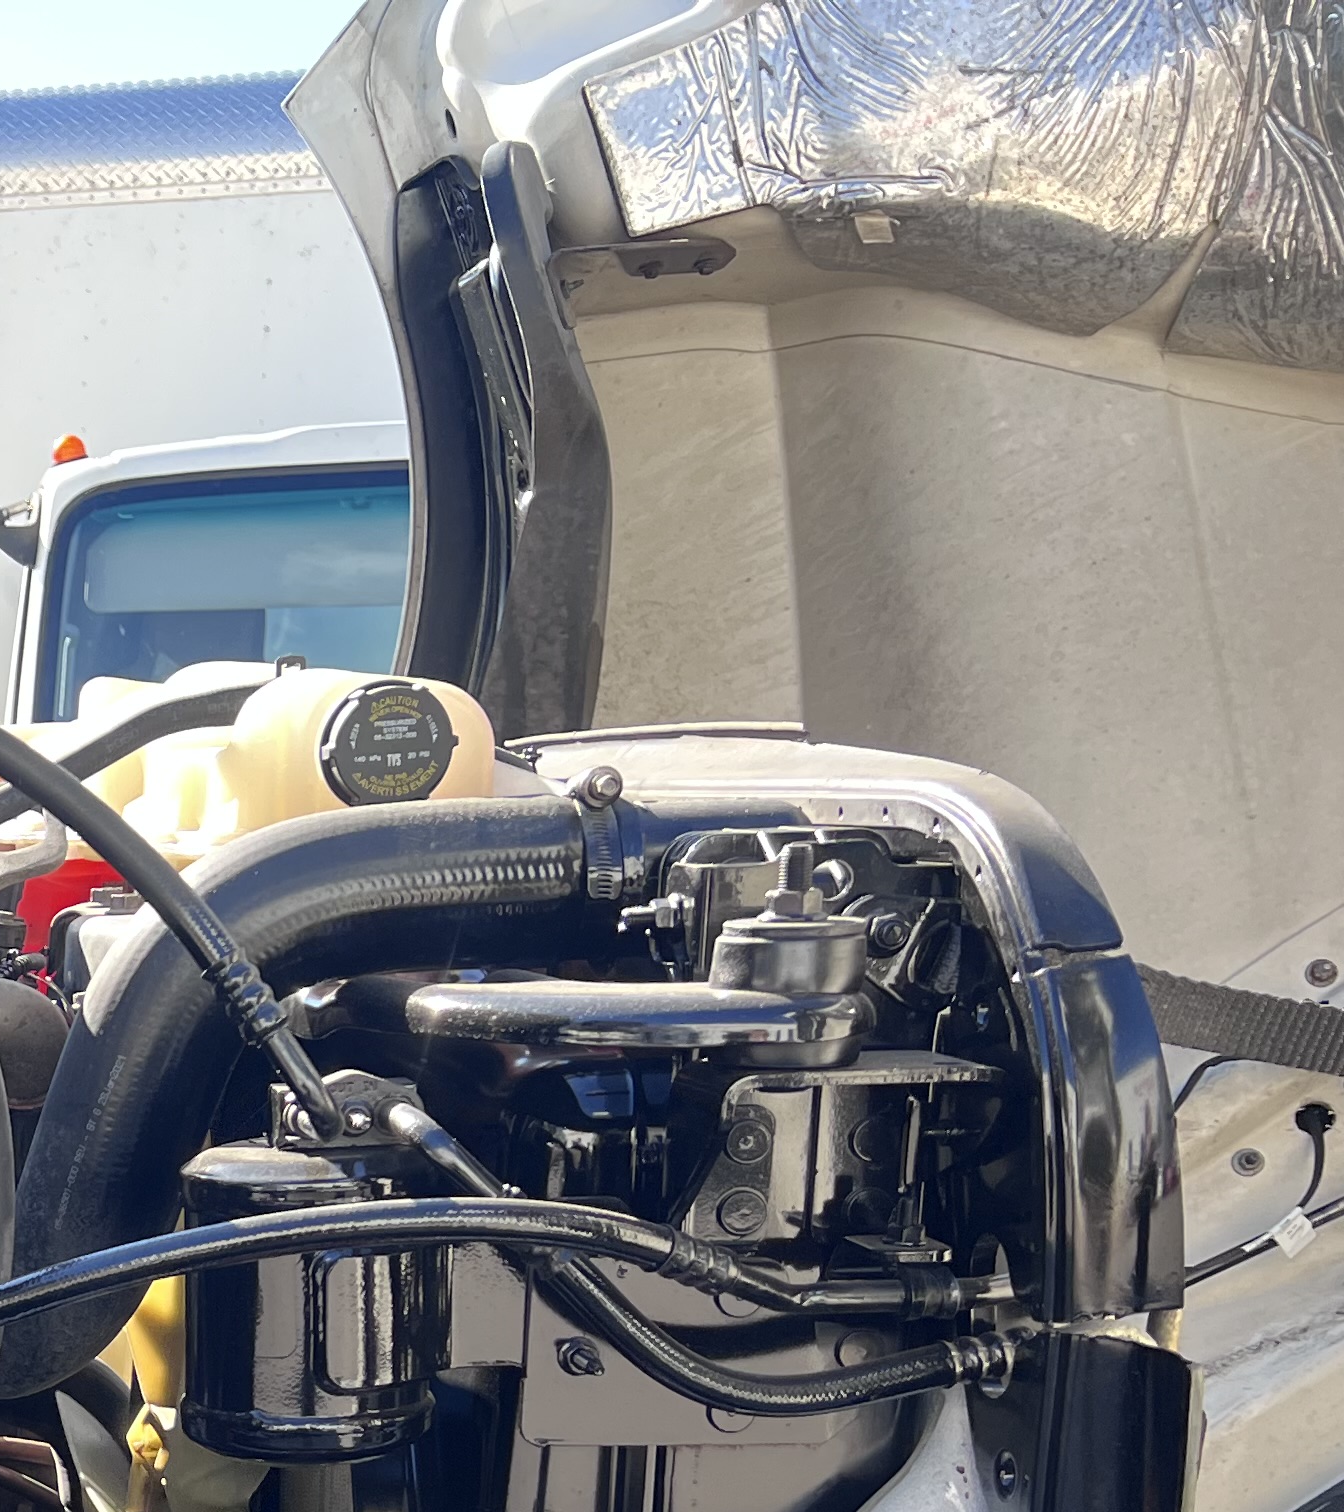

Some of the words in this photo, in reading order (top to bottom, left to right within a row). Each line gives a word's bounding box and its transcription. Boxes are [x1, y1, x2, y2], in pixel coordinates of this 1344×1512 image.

[379, 695, 420, 709] CAUTION
[391, 705, 409, 714] OPEN
[382, 726, 409, 734] SYSTEM
